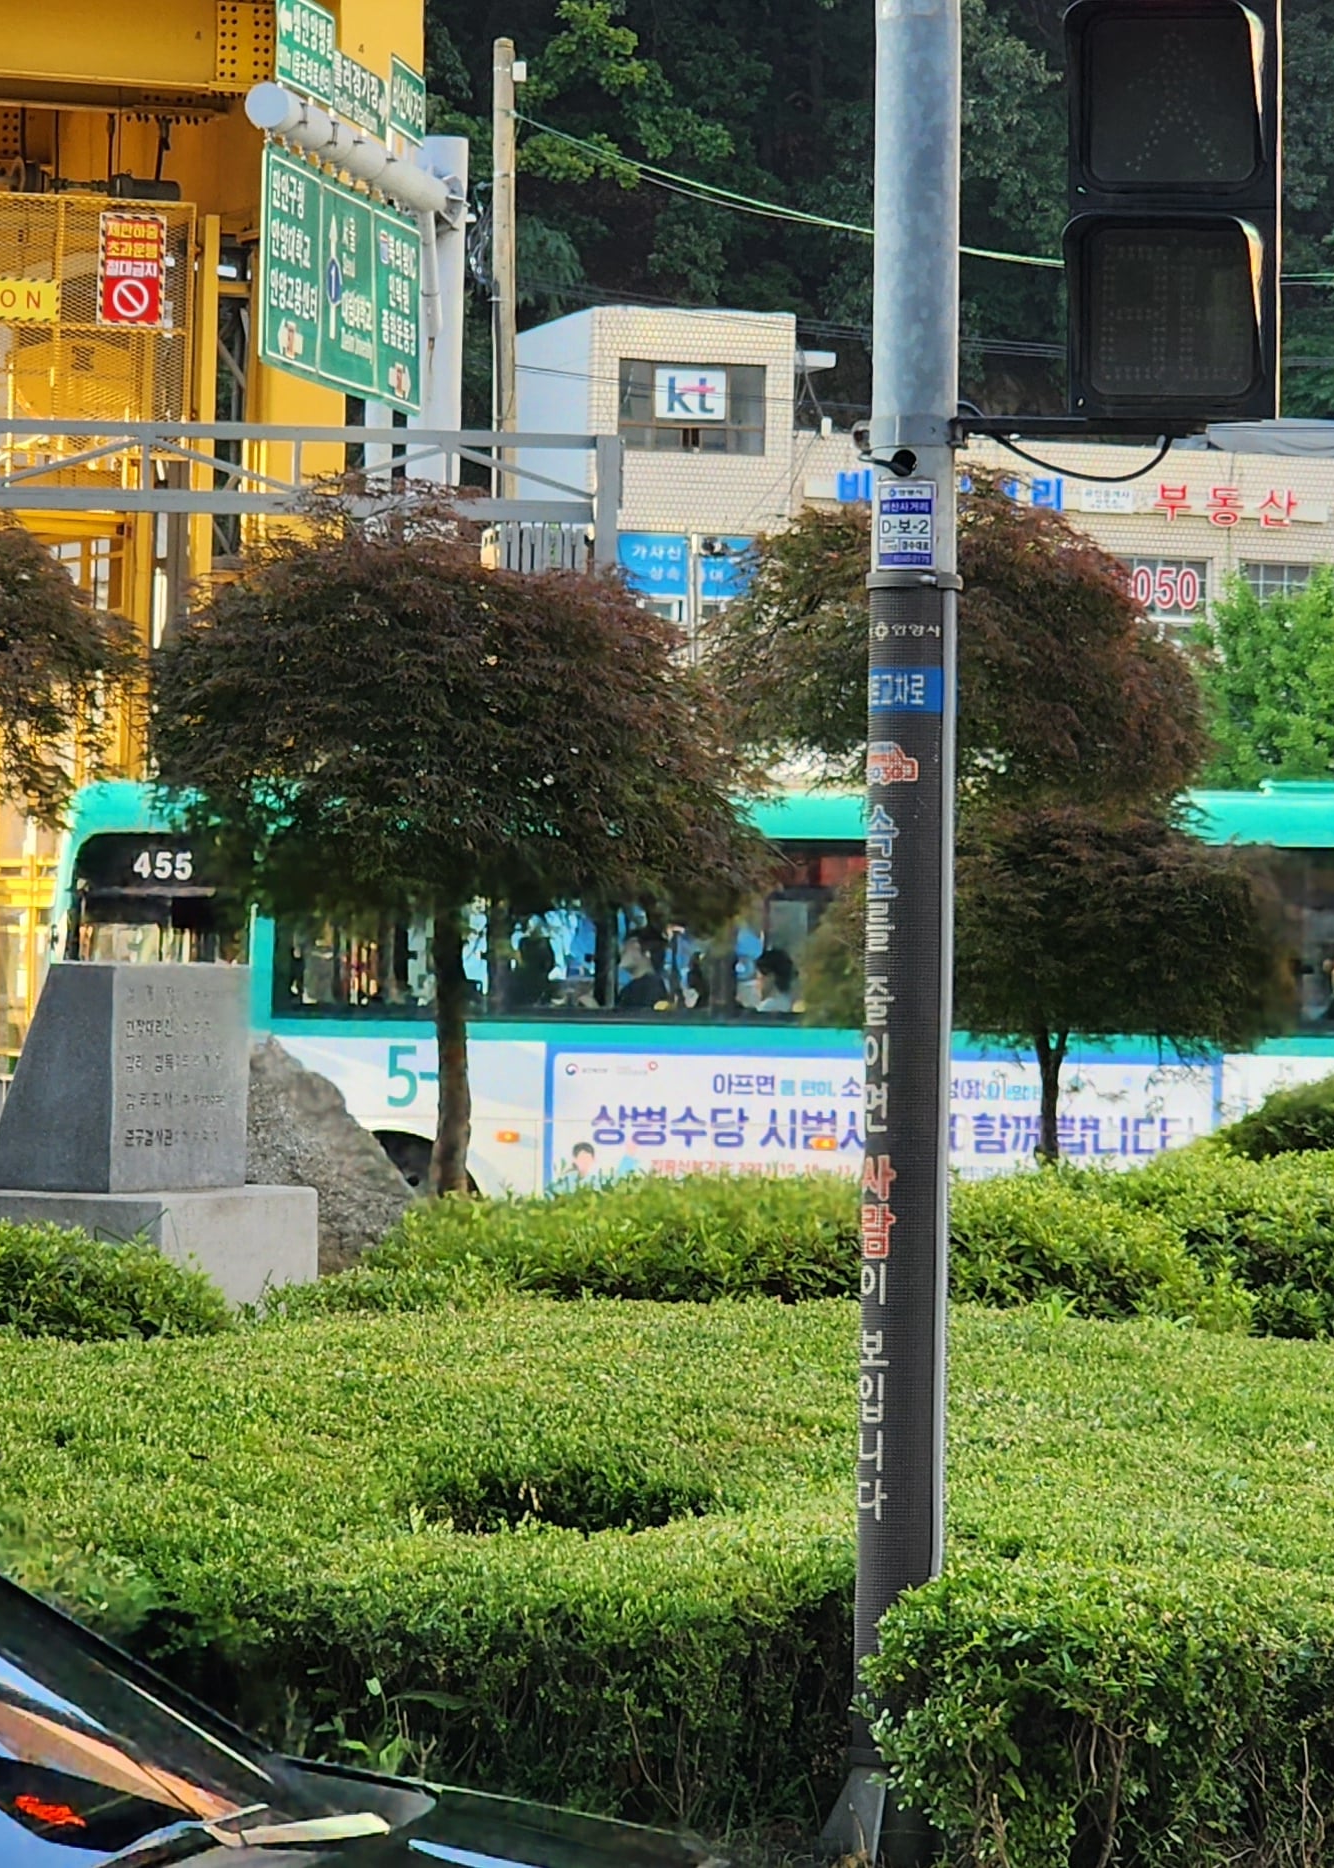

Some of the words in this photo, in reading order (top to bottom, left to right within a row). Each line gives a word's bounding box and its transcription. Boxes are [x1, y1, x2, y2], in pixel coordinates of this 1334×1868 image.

[271, 170, 305, 220] 만안구청
[107, 221, 158, 239] 제한하중
[270, 217, 311, 270] 안양대학교
[105, 259, 158, 277] 절대금지
[269, 267, 317, 324] 안양고용센터
[666, 375, 716, 414] kt
[882, 501, 930, 513] 비산사거리
[1153, 484, 1298, 528] 부동산
[881, 519, 930, 535] D-보-2
[891, 623, 941, 638] 안양시
[133, 851, 193, 881] 455
[864, 975, 896, 1133] 줄이면
[712, 1073, 776, 1097] 아프면
[590, 1104, 750, 1149] 상병수당
[861, 1155, 897, 1305] 사람이
[858, 1330, 890, 1521] 보입니다
